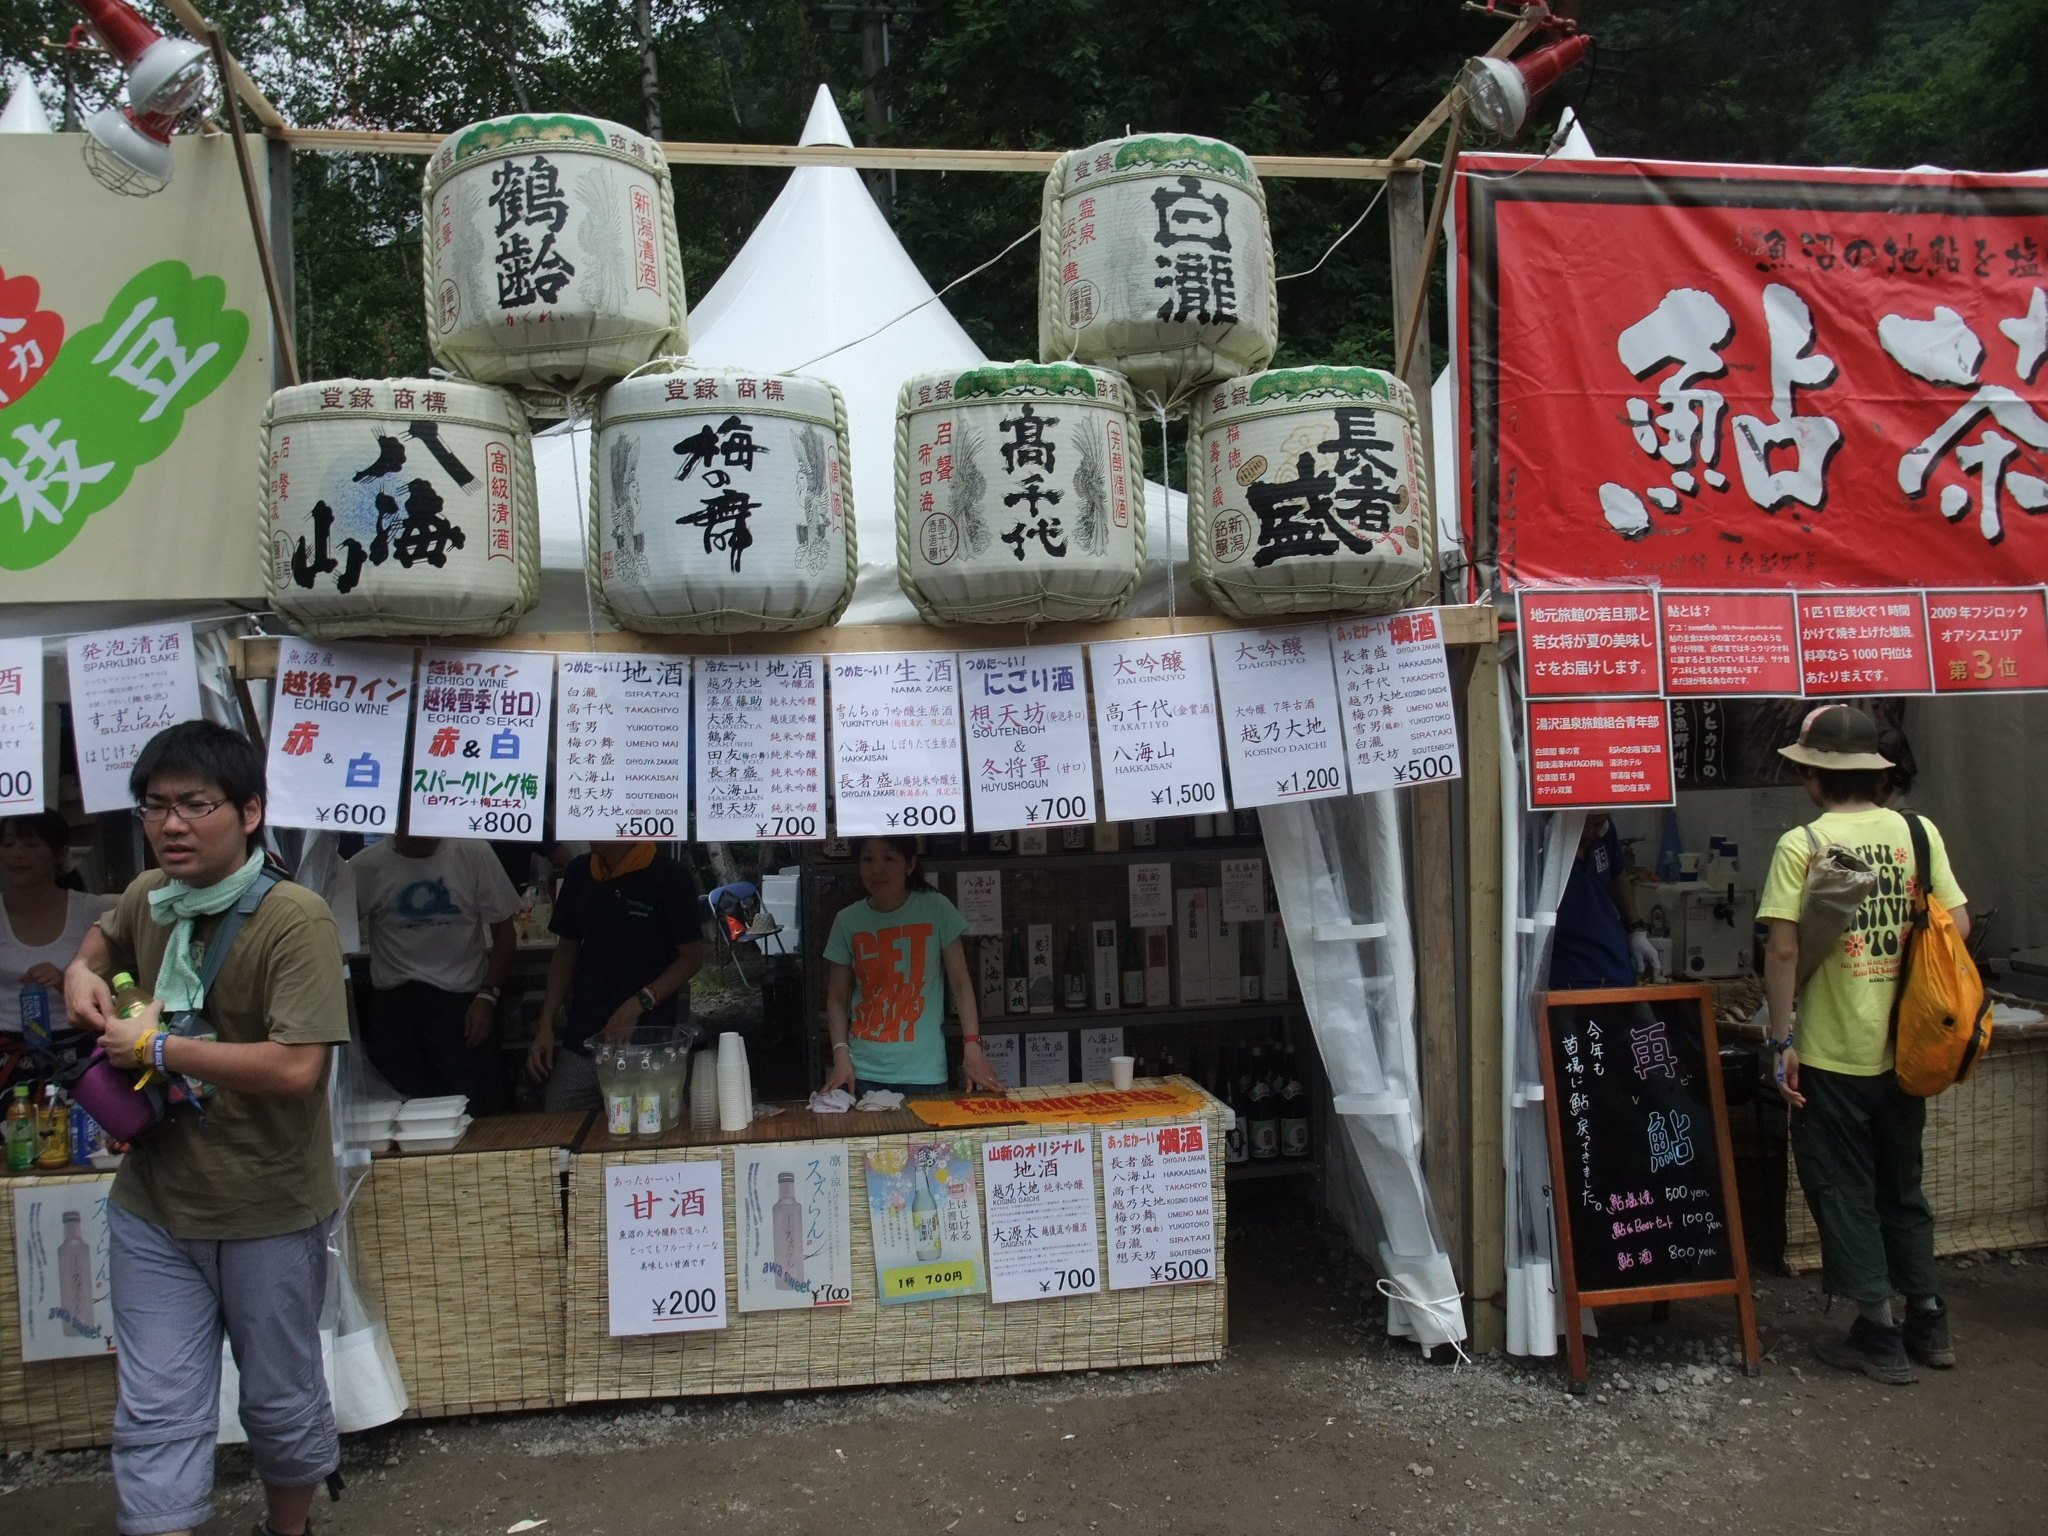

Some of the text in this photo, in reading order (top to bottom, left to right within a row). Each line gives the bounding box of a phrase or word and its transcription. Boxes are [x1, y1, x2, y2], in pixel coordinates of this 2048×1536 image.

[633, 190, 657, 288] 新潟清酒
[665, 378, 785, 402] 登録 商標
[320, 386, 449, 414] 登録 商標
[673, 415, 770, 575] 梅の舞
[1245, 409, 1401, 567] 長者盛
[291, 420, 483, 594] 八海山
[1530, 607, 1650, 622] 地元旅館の若旦那と
[1532, 633, 1653, 649] 若女将が夏の美味し
[1802, 626, 1915, 640] かけて焼き上げた塩焼。
[1941, 629, 2022, 642] オアシスエリア
[81, 633, 180, 662] 発泡清酒
[1235, 637, 1305, 662] 大吟醸
[83, 652, 180, 673] SPARKLING SAKE
[287, 650, 336, 667] 魚沼産
[1113, 650, 1185, 676] 大吟醸
[1238, 657, 1305, 670] DAIGINJYO
[427, 660, 519, 678] 越後ワイン
[622, 660, 683, 686] 地酒
[766, 660, 813, 679] 地酒
[894, 659, 952, 684] 生酒
[1534, 661, 1649, 676] さをお届けします。
[1806, 669, 1889, 683] あたりまえです。
[282, 670, 407, 702] 越後ワイン
[426, 675, 508, 688] ECHIGO WINE
[706, 677, 762, 690] 越乃大地
[891, 685, 953, 694] NAMA ZAKE
[984, 666, 1074, 696] にごり酒
[567, 686, 598, 698] 白瀧
[294, 698, 389, 716] ECHIGO WINE
[567, 703, 614, 715] 高千代
[769, 697, 817, 707] 純米大吟醸
[1106, 699, 1172, 722] 高千代
[87, 704, 176, 730] すずらん
[427, 713, 534, 728] ECHIGO SEKKI
[970, 701, 1046, 730] 想天坊
[1536, 716, 1659, 730] 湯沢温泉旅館組合青年部
[101, 719, 171, 736] SUZURAN
[567, 720, 598, 733] 雪男
[973, 725, 1045, 738] SOUTENBOH
[1240, 717, 1326, 743] 越乃大地
[427, 726, 520, 760] 赤 & 白
[567, 737, 615, 749] 梅の舞
[769, 732, 818, 742] 純米吟醸
[839, 740, 885, 753] 八海山
[1014, 740, 1026, 752] &
[281, 720, 381, 788] 赤 & 白
[1113, 741, 1175, 763] 八海山
[1244, 741, 1326, 758] KOSINO DAICHI
[567, 753, 615, 766] 長者盛
[981, 754, 1050, 781] 冬将軍
[1115, 762, 1172, 774] HAKKAISAN
[1393, 755, 1453, 781] ¥500
[567, 770, 615, 783] 八海山
[708, 766, 818, 778] 長者盛 純米吟醸
[838, 773, 892, 789] 長者盛
[1277, 767, 1339, 792] ¥1,200
[413, 769, 538, 799] スパークリング梅
[567, 787, 614, 800] 想天坊
[710, 783, 818, 796] 八海山 純米吟醸
[981, 779, 1049, 792] HUYUSHOGUN
[1151, 782, 1215, 807] ¥1,500
[316, 802, 386, 826] ¥600
[567, 805, 624, 818] 越乃大地
[710, 802, 818, 815] 想天坊 純米吟醸
[886, 805, 956, 827] ¥800
[1025, 796, 1086, 821] ¥700
[468, 811, 532, 834] ¥800
[615, 817, 674, 837] ¥500
[756, 816, 816, 836] ¥700
[1586, 1020, 1604, 1076] 今年も
[1562, 1034, 1602, 1211] 苗場に鮎戻ってきました。
[989, 1139, 1085, 1161] 山新のオリジナル
[1647, 1109, 1694, 1173] 鮎
[1013, 1159, 1058, 1178] 地酒
[993, 1179, 1084, 1199] 越乃大地 純米吟醸
[624, 1188, 706, 1221] 甘酒
[1606, 1186, 1688, 1215] 鮎塩焼 500
[958, 1198, 971, 1241] はじける
[1682, 1211, 1713, 1227] 1000
[993, 1224, 1038, 1242] 大源太
[630, 1241, 718, 1255] とってもフルーティーな
[1116, 1238, 1142, 1249] 白瀧
[1668, 1245, 1695, 1259] 800
[639, 1258, 707, 1271] 美味しい甘酒です
[1116, 1251, 1156, 1263] 想天坊
[762, 1261, 812, 1293] awa sweet
[1150, 1259, 1208, 1280] ¥500
[652, 1288, 716, 1316] ¥200
